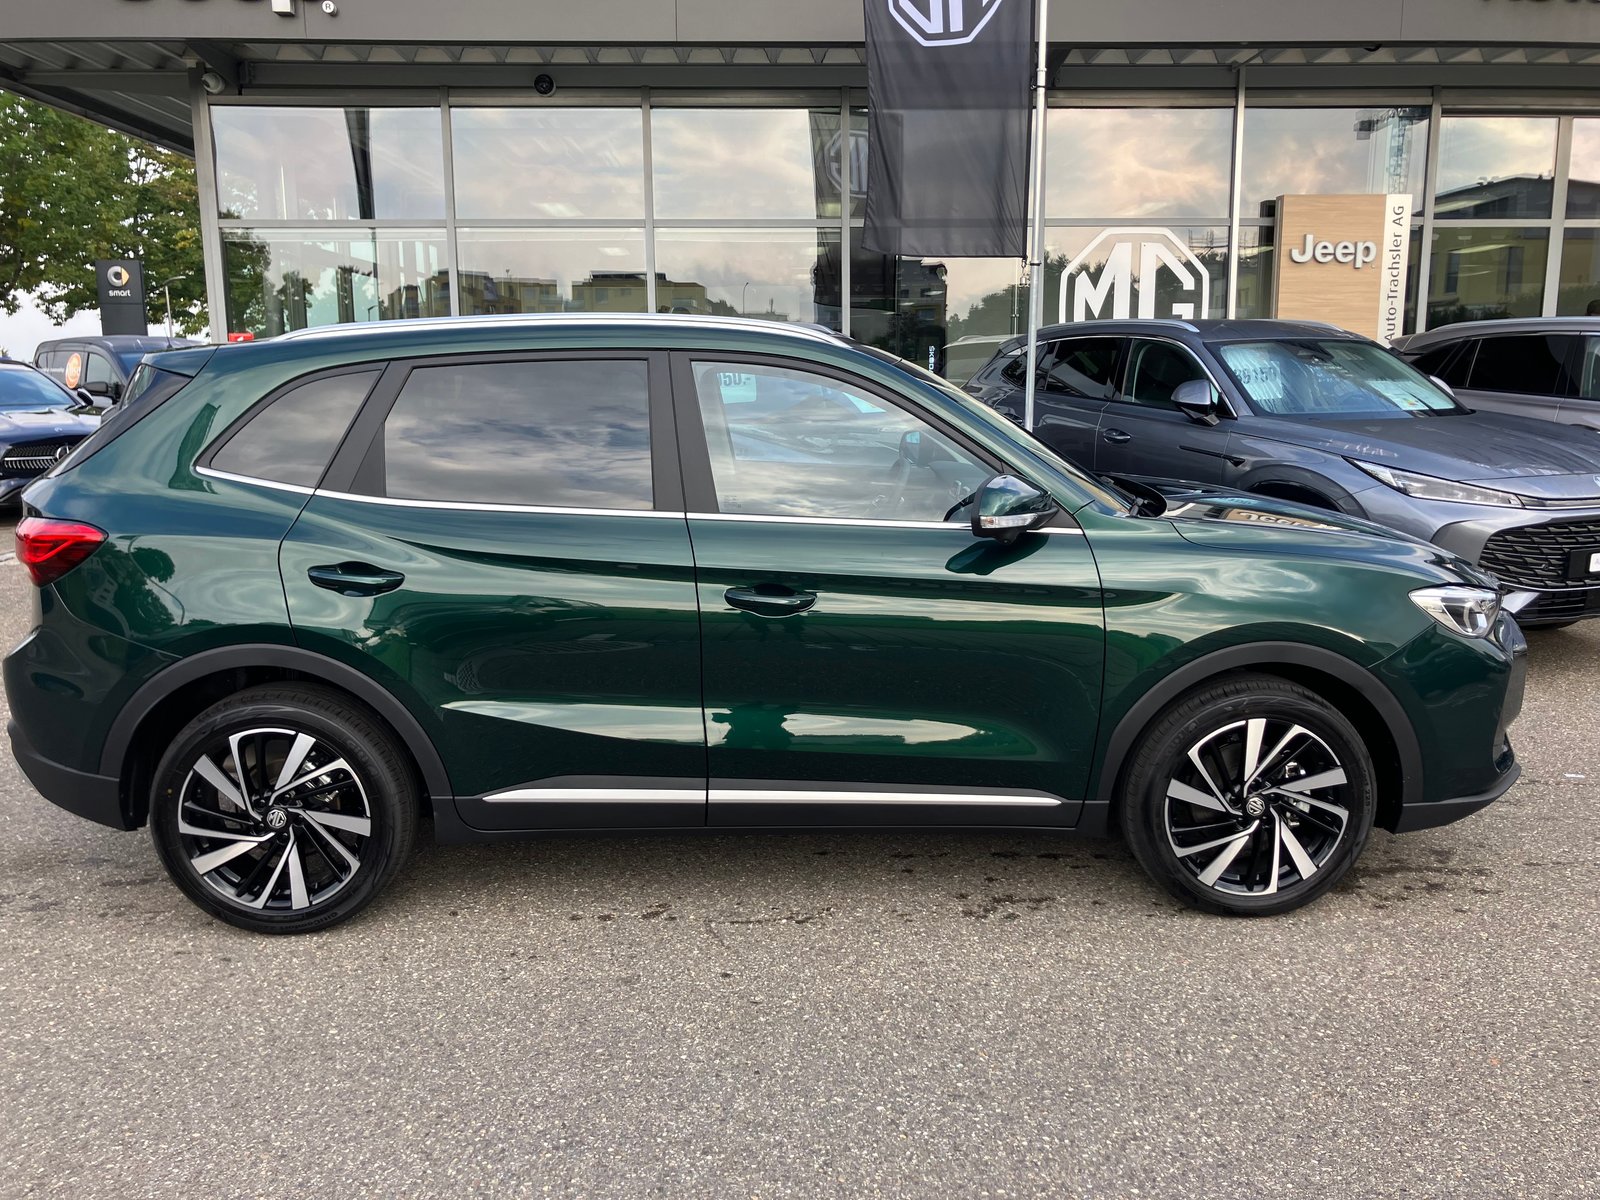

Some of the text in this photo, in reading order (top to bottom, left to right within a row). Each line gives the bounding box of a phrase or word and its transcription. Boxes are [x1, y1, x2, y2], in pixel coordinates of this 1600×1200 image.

[1290, 234, 1377, 269] Jeep
[1073, 242, 1195, 322] MG
[1384, 205, 1405, 341] Auto-Trachsler AG
[108, 289, 132, 297] smart
[268, 810, 286, 827] MG
